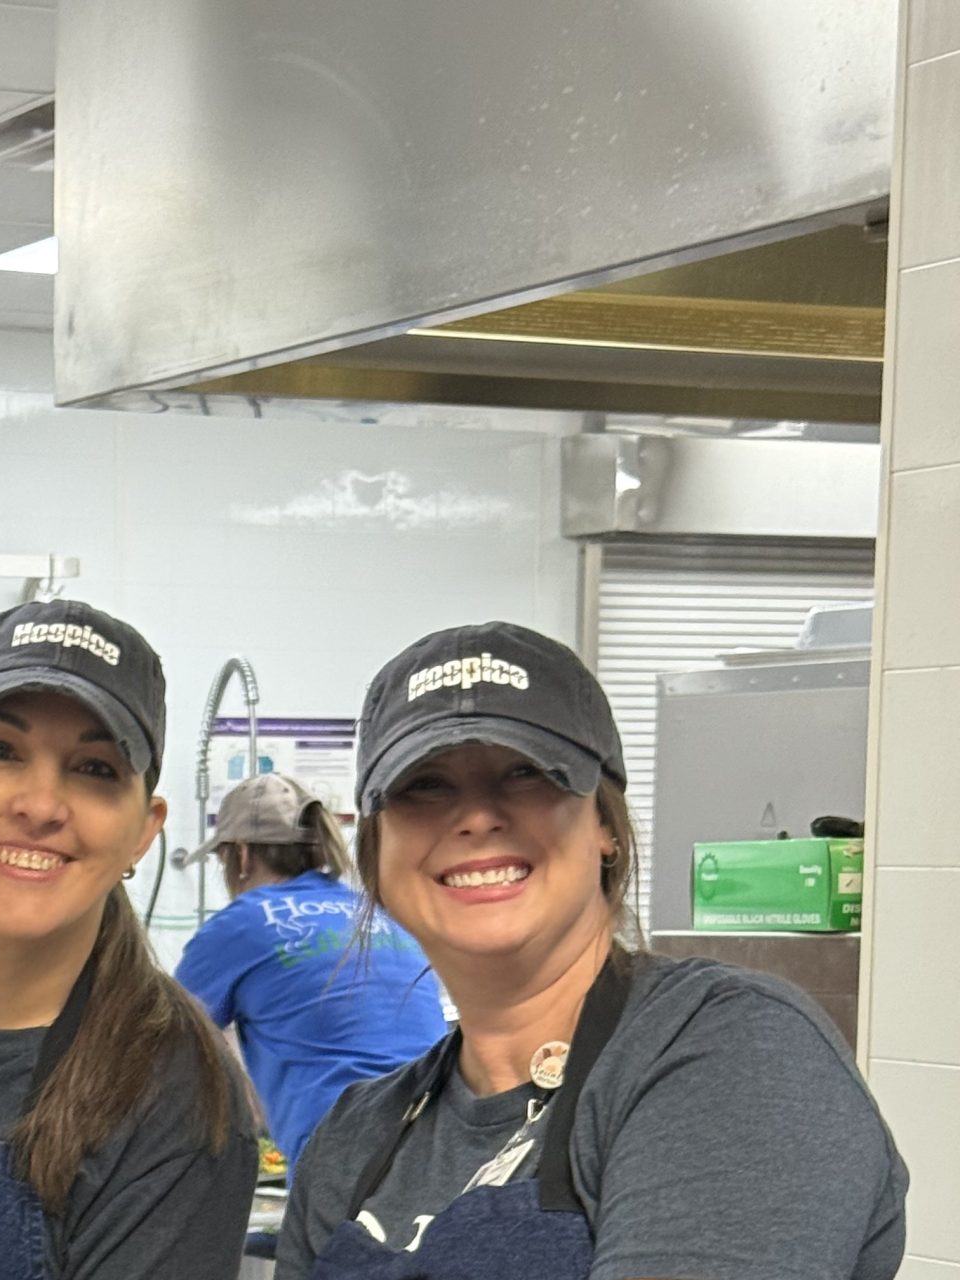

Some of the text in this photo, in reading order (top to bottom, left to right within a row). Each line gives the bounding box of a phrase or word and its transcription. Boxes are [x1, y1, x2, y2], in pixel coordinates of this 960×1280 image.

[11, 622, 121, 667] Hospice
[406, 652, 530, 702] Hospice
[792, 912, 821, 924] GLOVES
